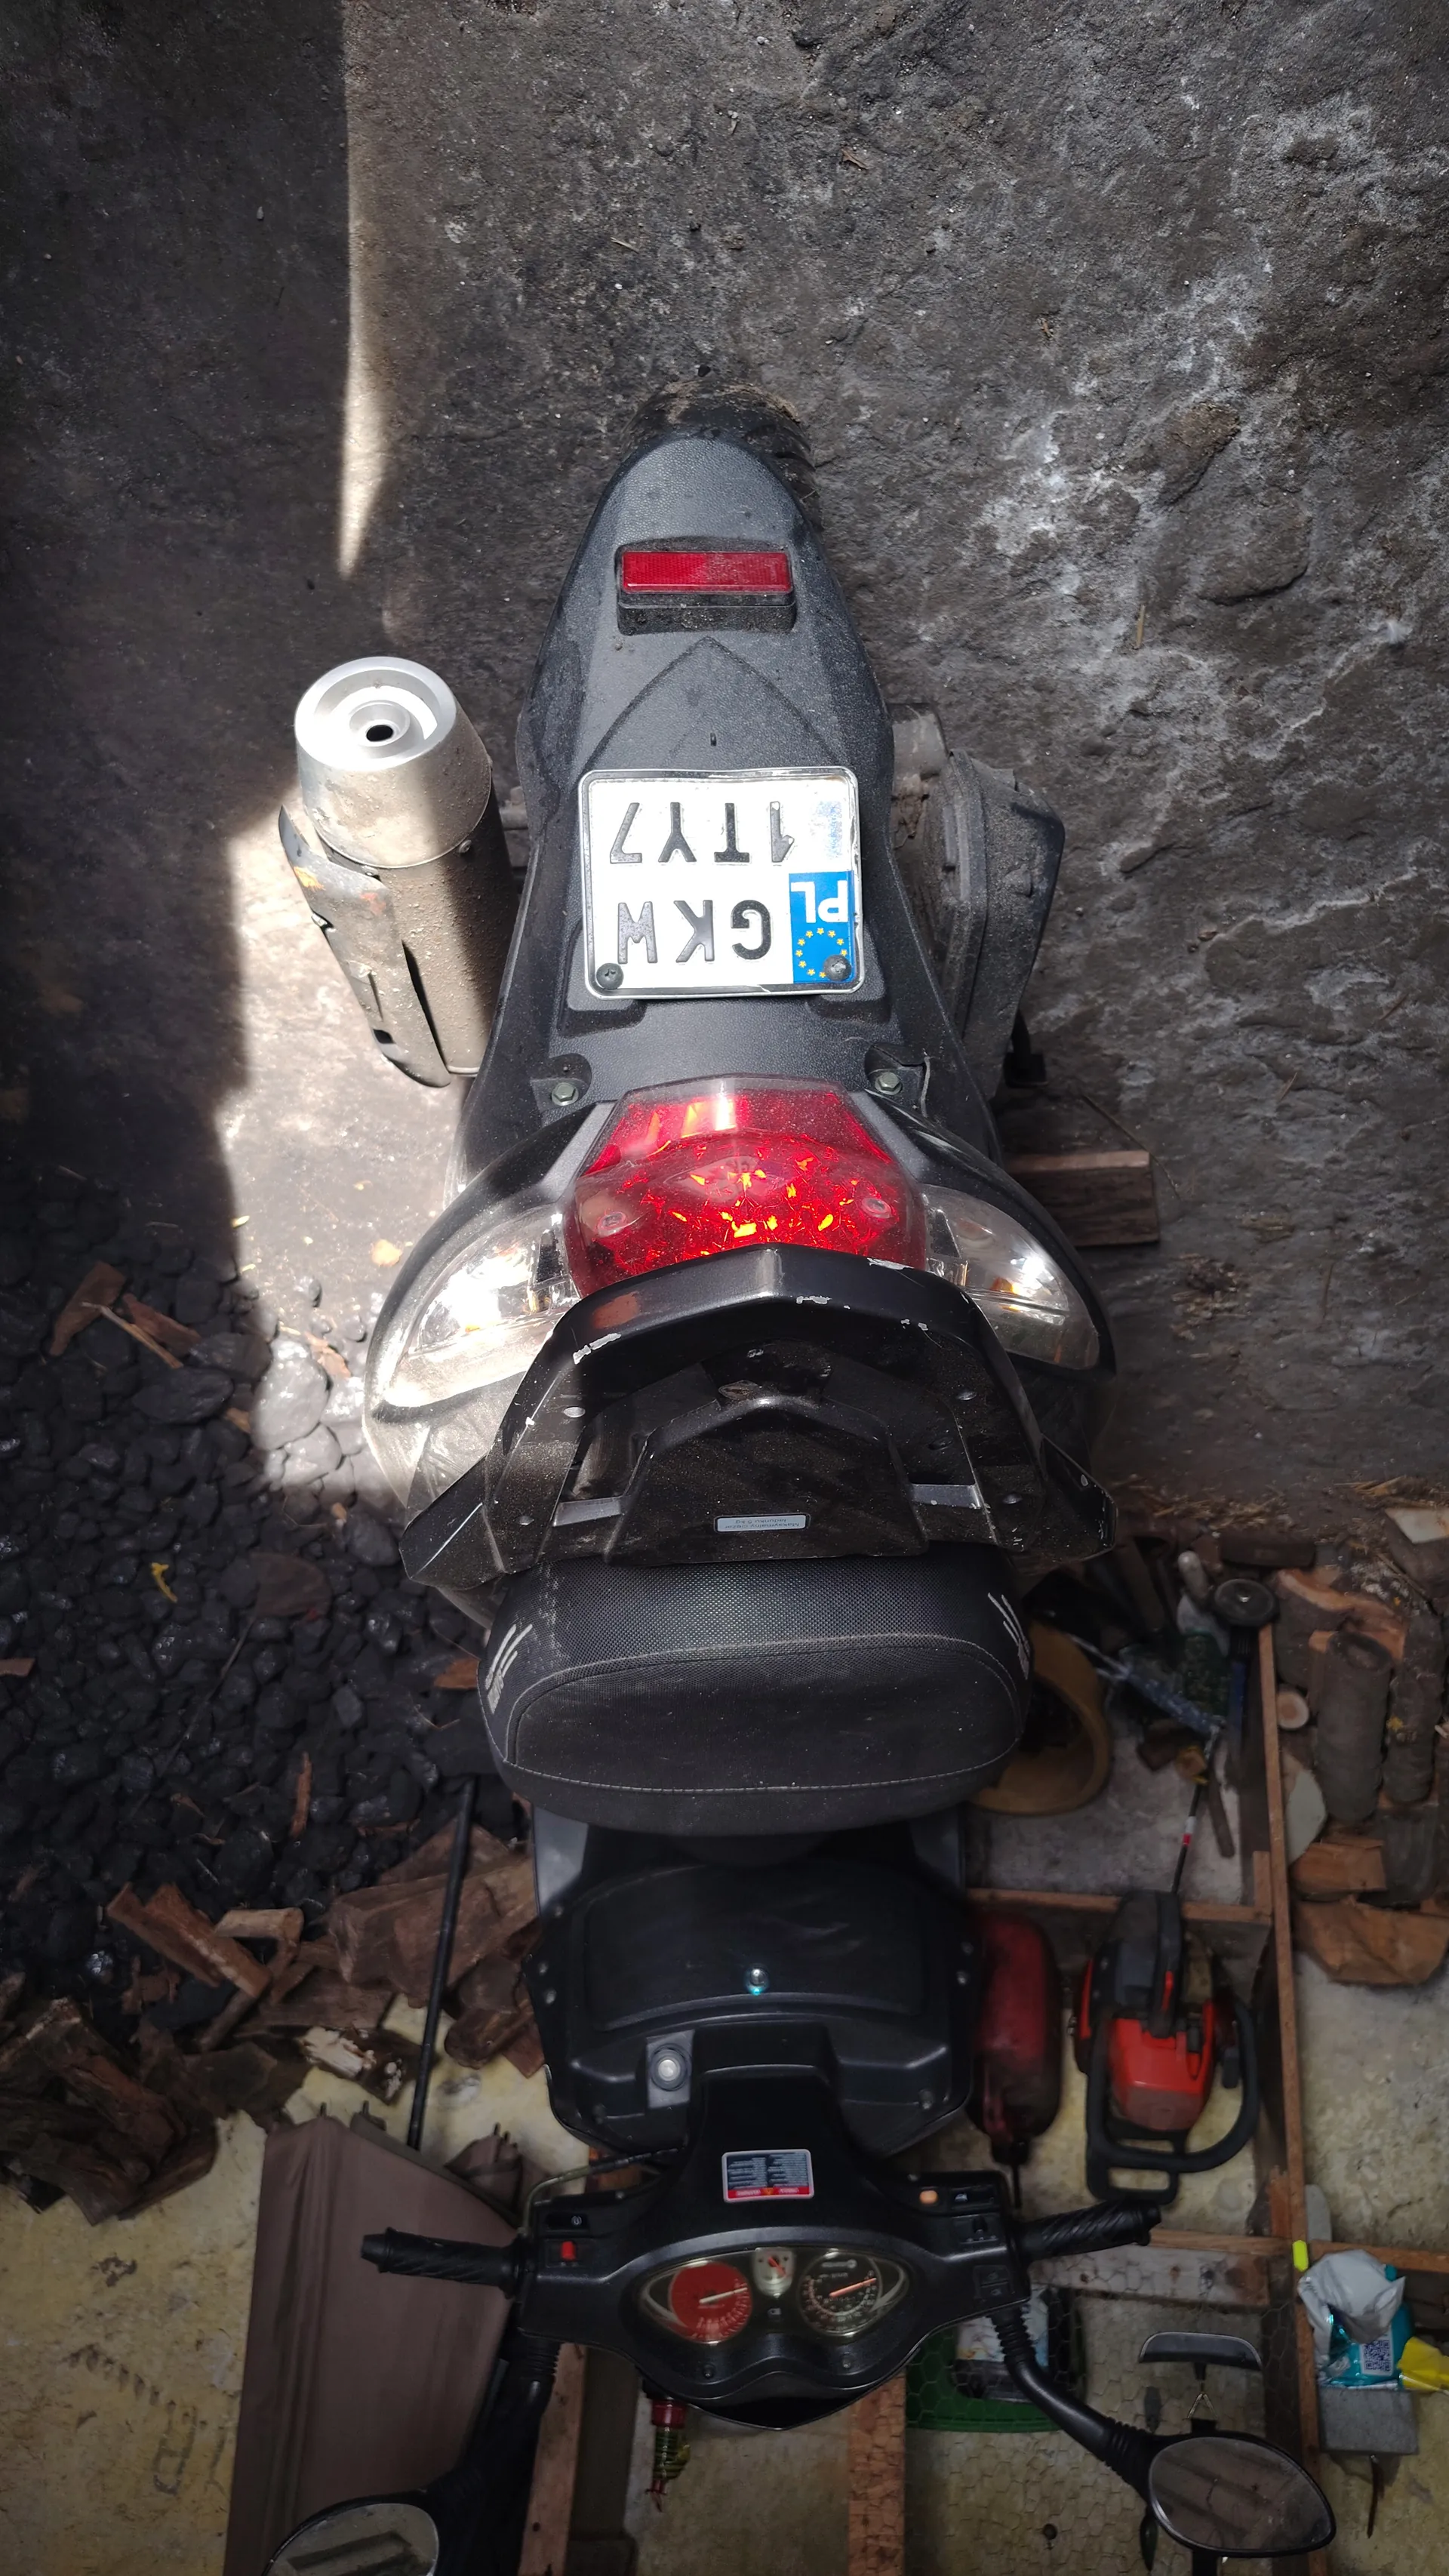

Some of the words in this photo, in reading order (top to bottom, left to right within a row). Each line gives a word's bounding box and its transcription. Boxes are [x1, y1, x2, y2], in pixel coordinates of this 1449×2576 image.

[609, 801, 795, 864] 1TY7
[617, 900, 772, 964] GKW
[790, 880, 848, 924] PL
